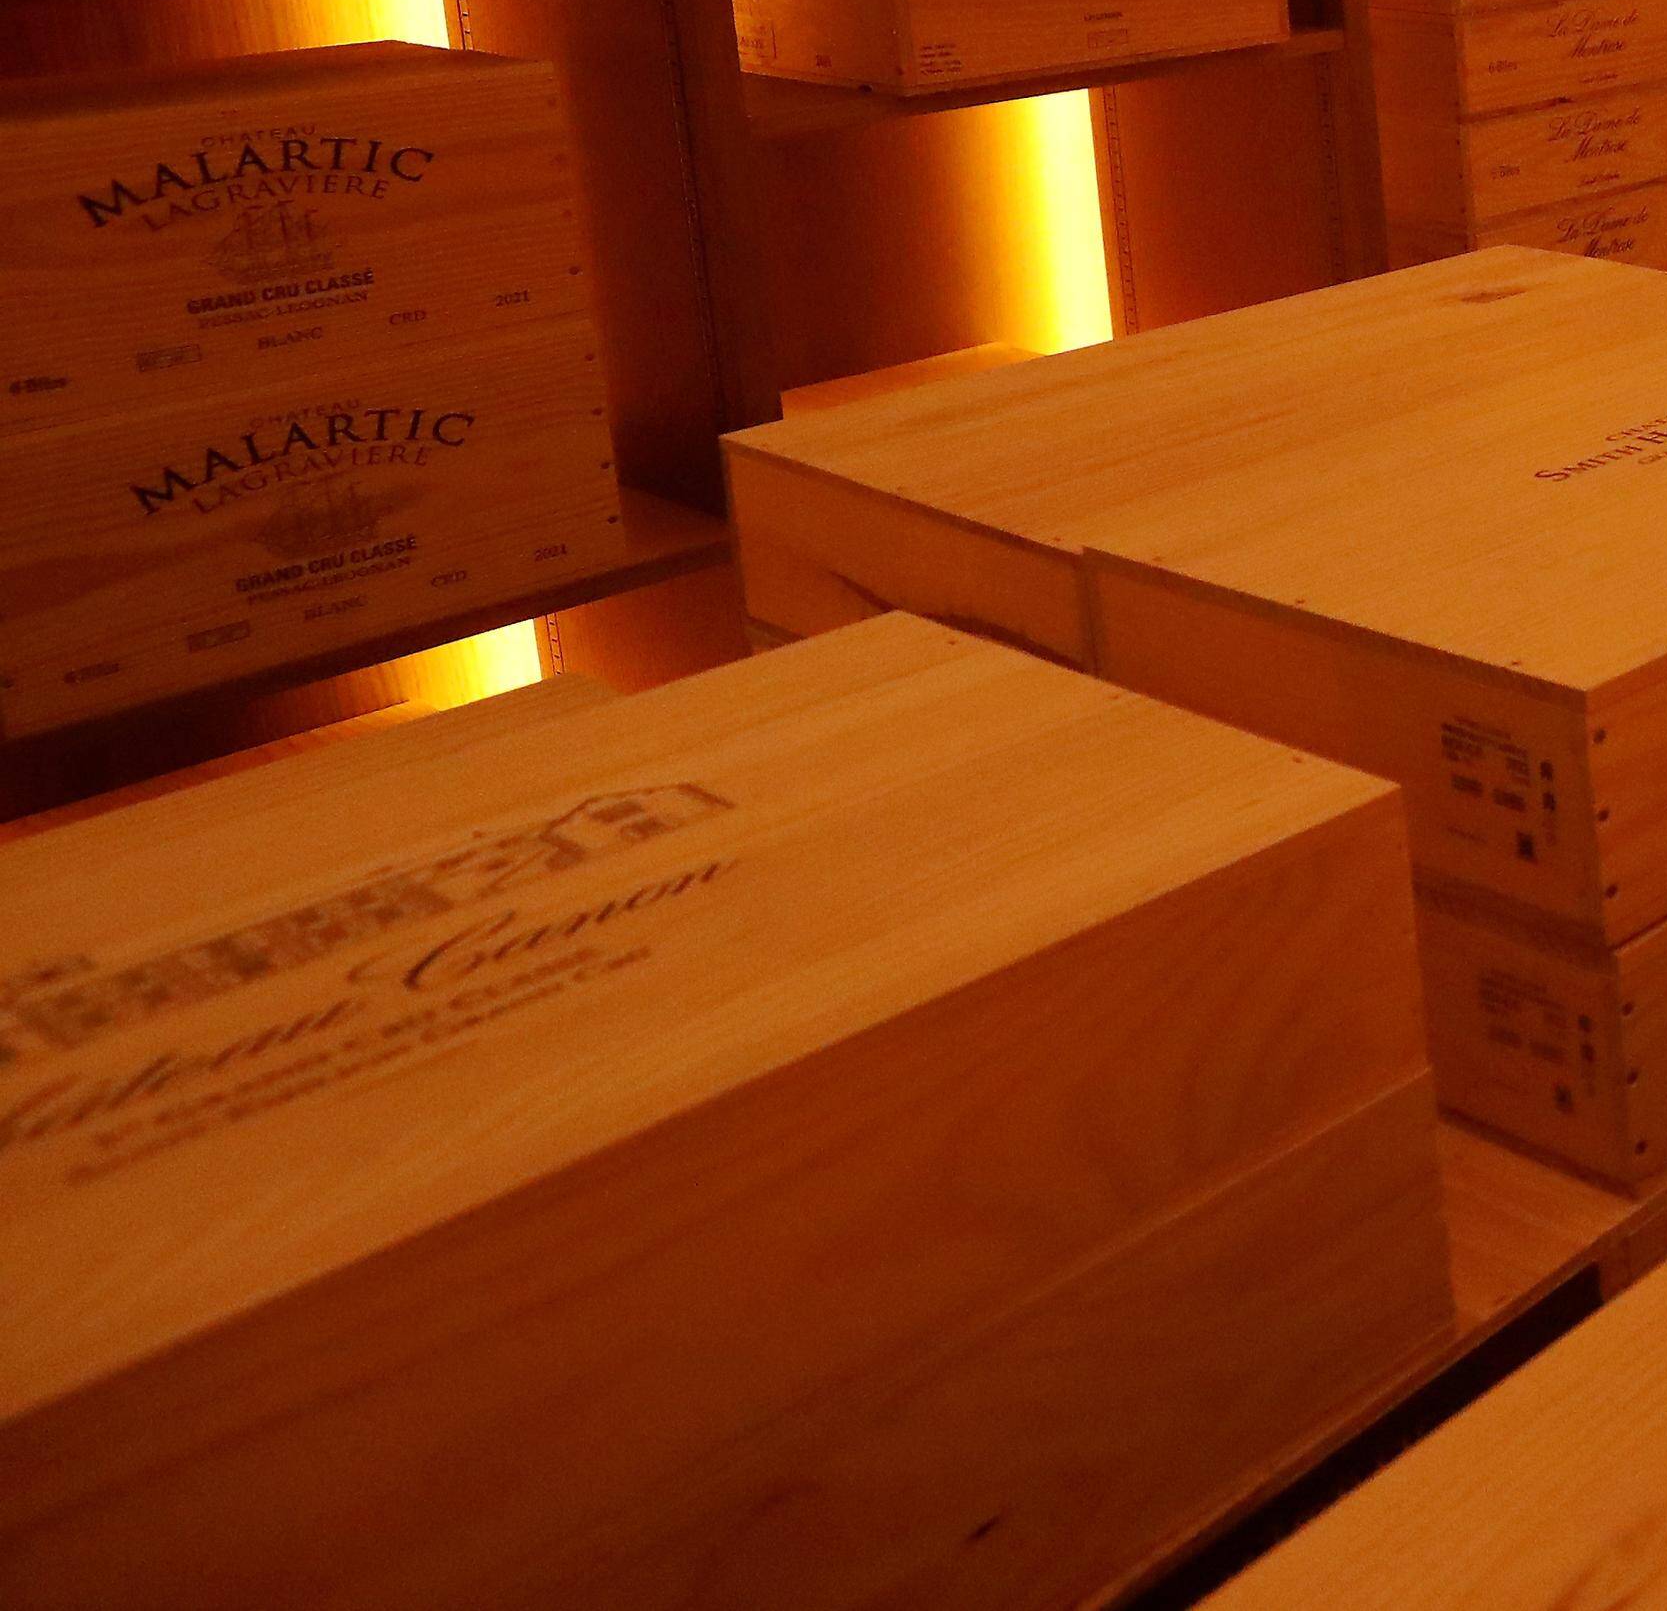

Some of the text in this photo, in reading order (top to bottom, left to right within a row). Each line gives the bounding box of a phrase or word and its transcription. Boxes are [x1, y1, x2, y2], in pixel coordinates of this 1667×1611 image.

[74, 135, 436, 230] MALARTIC
[186, 290, 257, 317] GRAND
[262, 281, 300, 304] CRU
[494, 289, 531, 307] 2021
[256, 325, 325, 351] BLANC
[127, 406, 475, 518] MALARTIC
[1532, 443, 1645, 483] SMITH
[234, 564, 303, 595] GRAND
[308, 551, 347, 578] CRU
